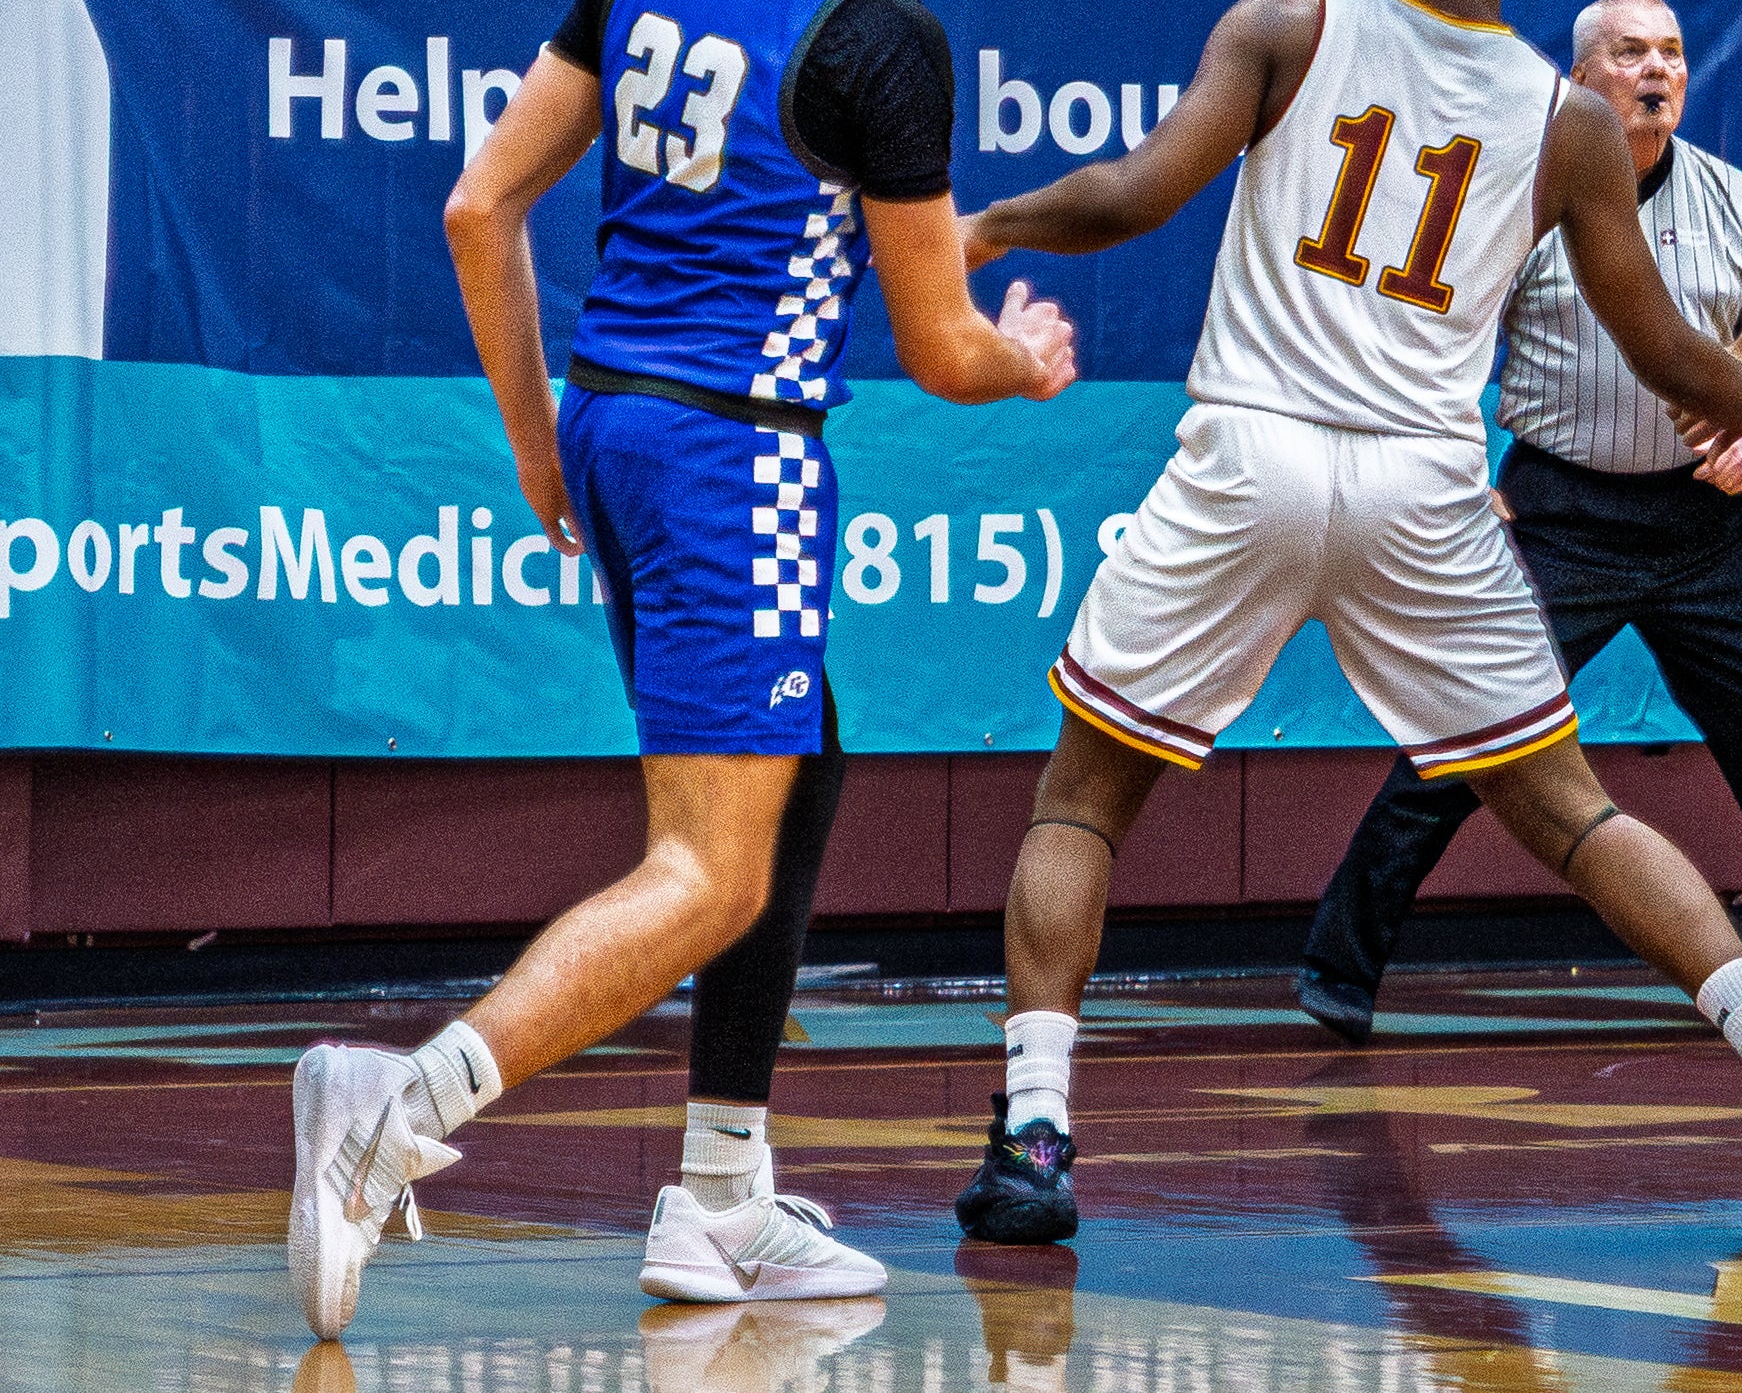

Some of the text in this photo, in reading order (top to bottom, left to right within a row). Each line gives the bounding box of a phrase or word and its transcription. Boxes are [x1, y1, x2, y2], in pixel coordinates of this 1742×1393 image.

[615, 11, 749, 194] 23
[1293, 104, 1483, 315] 11
[828, 507, 1064, 618] 815)
